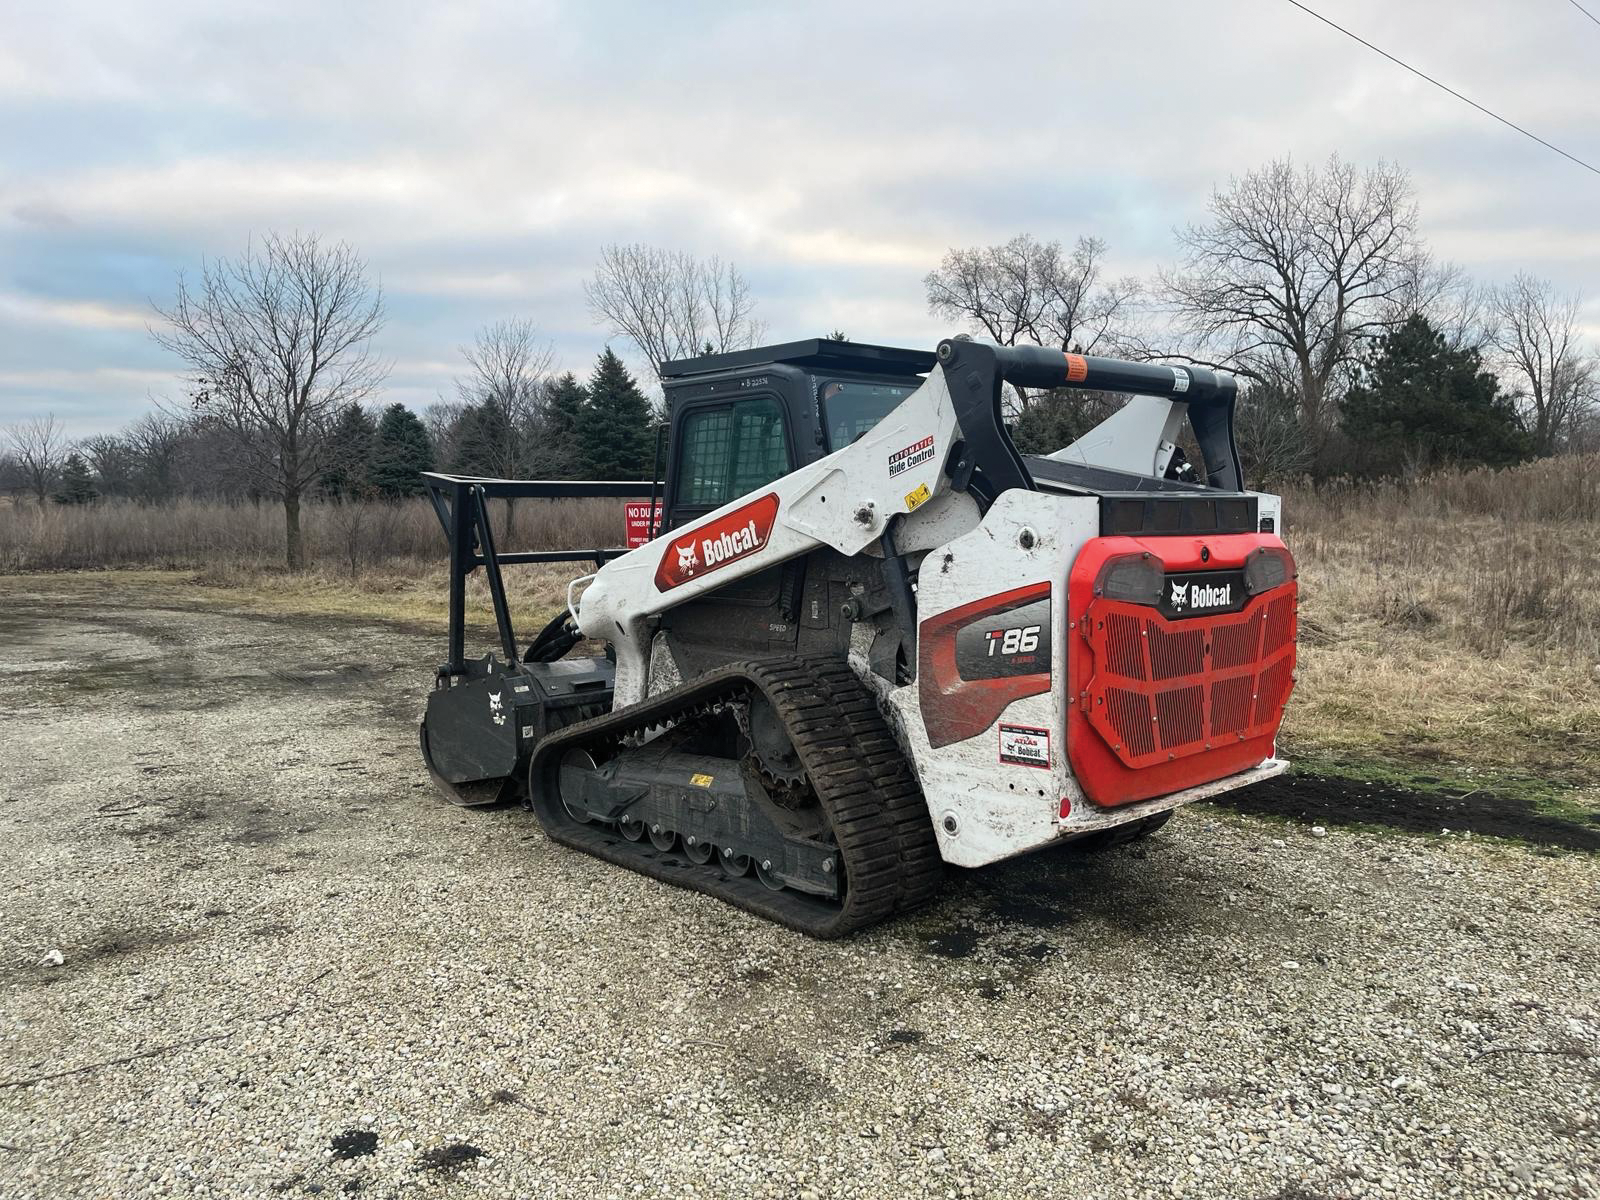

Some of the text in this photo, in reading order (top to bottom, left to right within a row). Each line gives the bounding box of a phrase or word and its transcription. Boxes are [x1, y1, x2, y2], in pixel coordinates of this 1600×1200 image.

[889, 437, 933, 464] AUTOMATIC
[889, 445, 935, 476] Ride Control
[628, 507, 640, 518] NO
[702, 519, 759, 567] Bobcat
[1191, 583, 1231, 608] Bobcat
[985, 625, 1041, 657] T86
[1017, 746, 1041, 758] Bobcat
